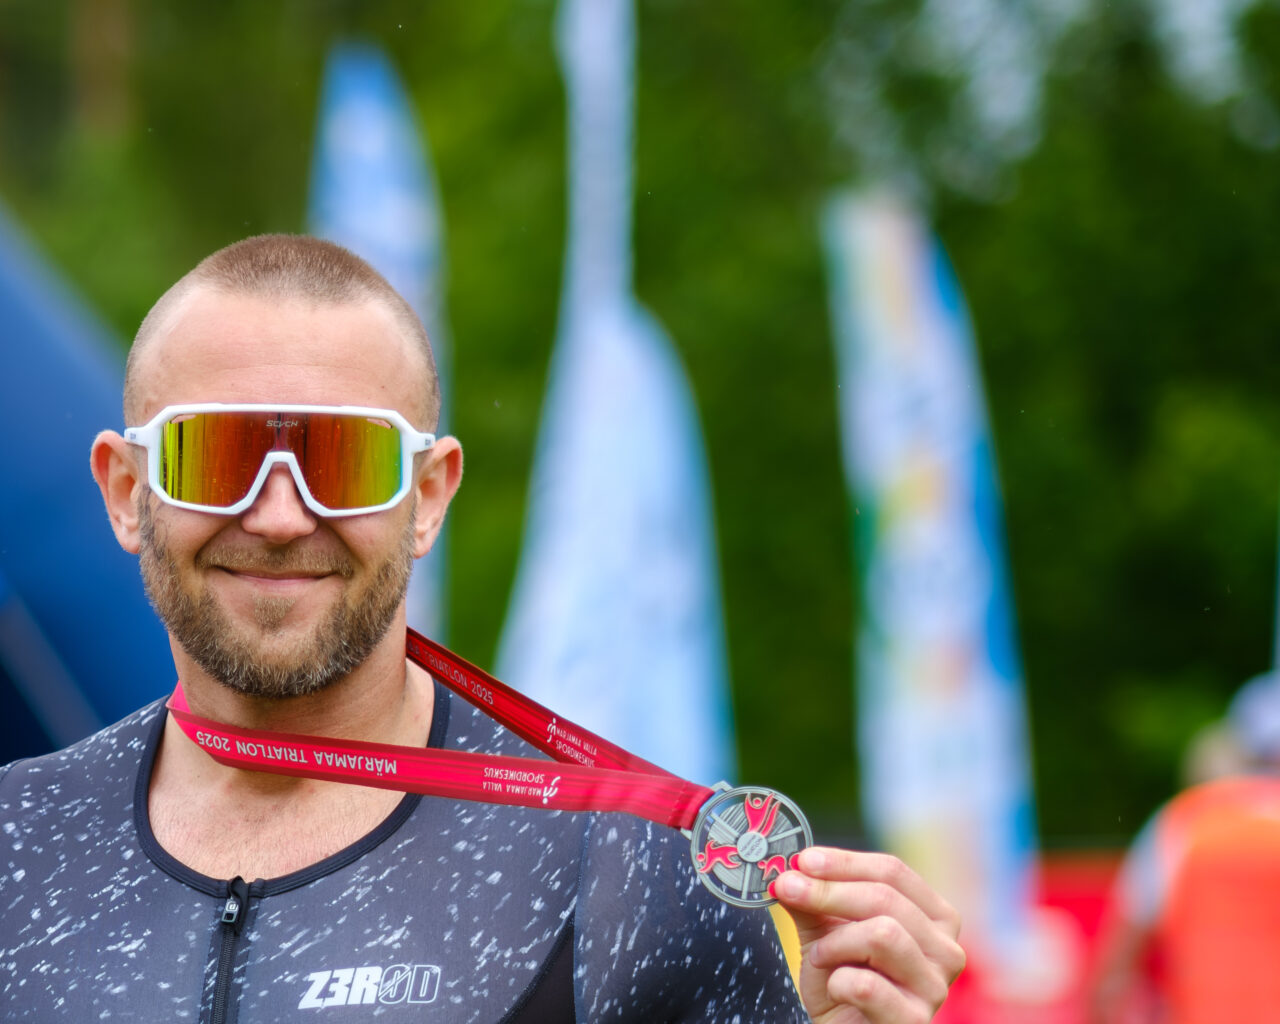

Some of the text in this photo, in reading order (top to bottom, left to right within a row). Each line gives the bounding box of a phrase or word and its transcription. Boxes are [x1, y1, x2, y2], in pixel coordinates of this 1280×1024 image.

[423, 651, 494, 705] TRIATLON 2025
[196, 731, 397, 776] MÄRJAMAA TRIATLON 2025
[482, 781, 502, 792] VALLA
[483, 767, 545, 784] SPORDIKESKUS
